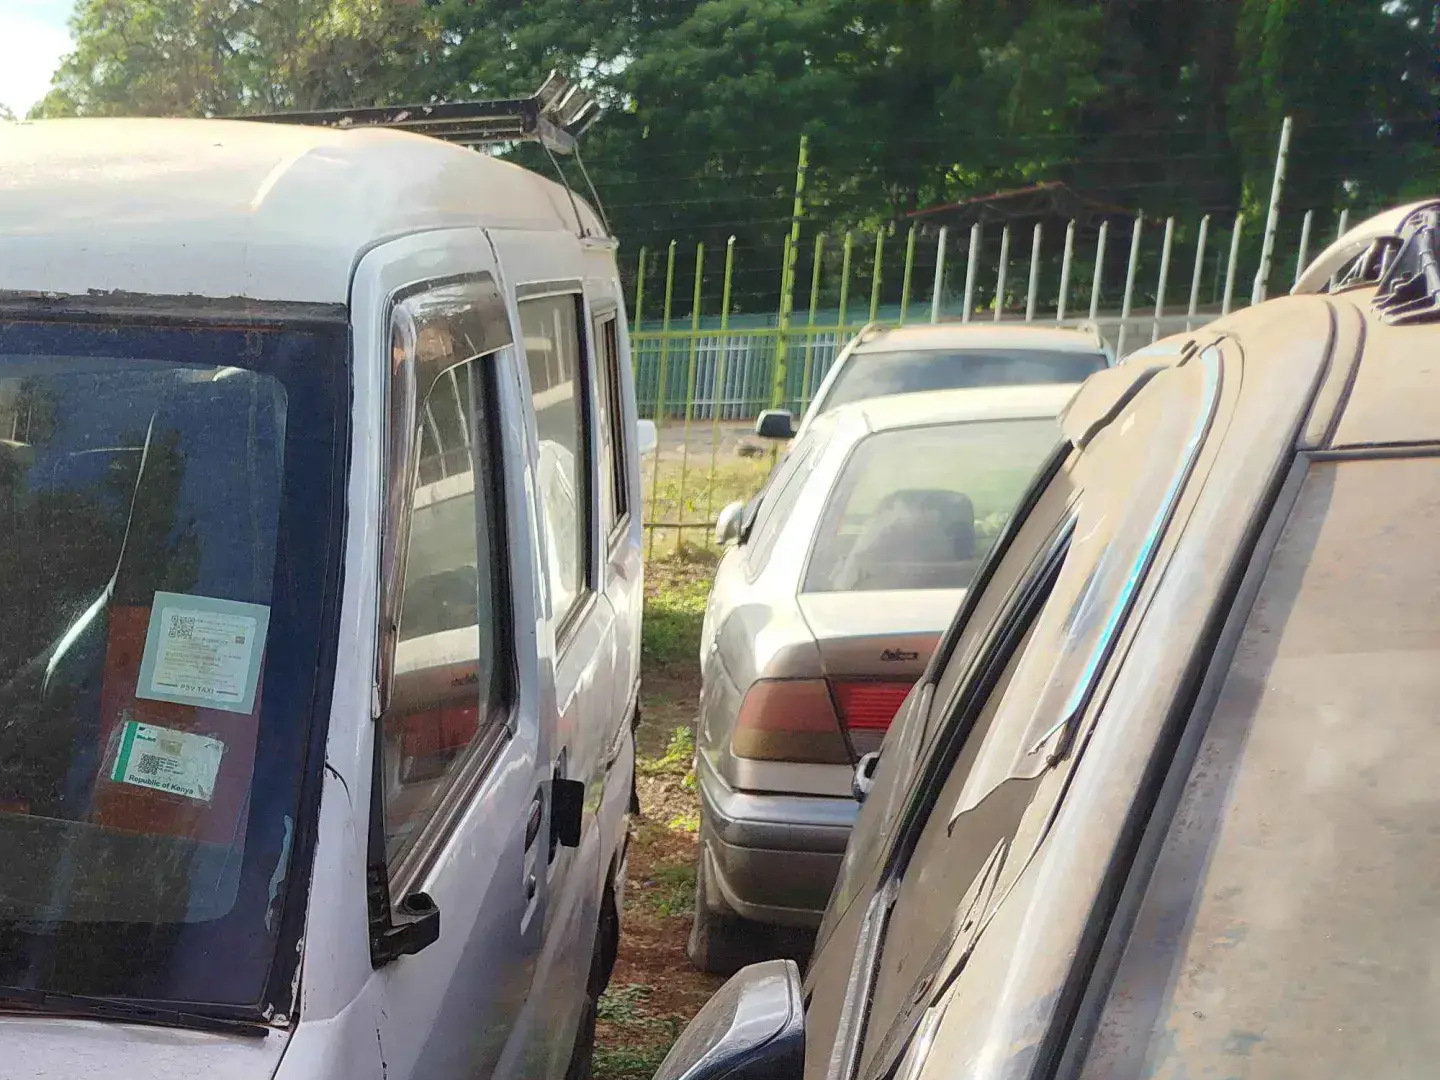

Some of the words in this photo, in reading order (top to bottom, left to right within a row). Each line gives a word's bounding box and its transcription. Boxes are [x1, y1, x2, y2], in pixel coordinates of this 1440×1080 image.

[180, 684, 196, 692] PSV
[197, 686, 215, 694] TAXI
[128, 774, 161, 788] Republic
[170, 784, 194, 796] Kenya
